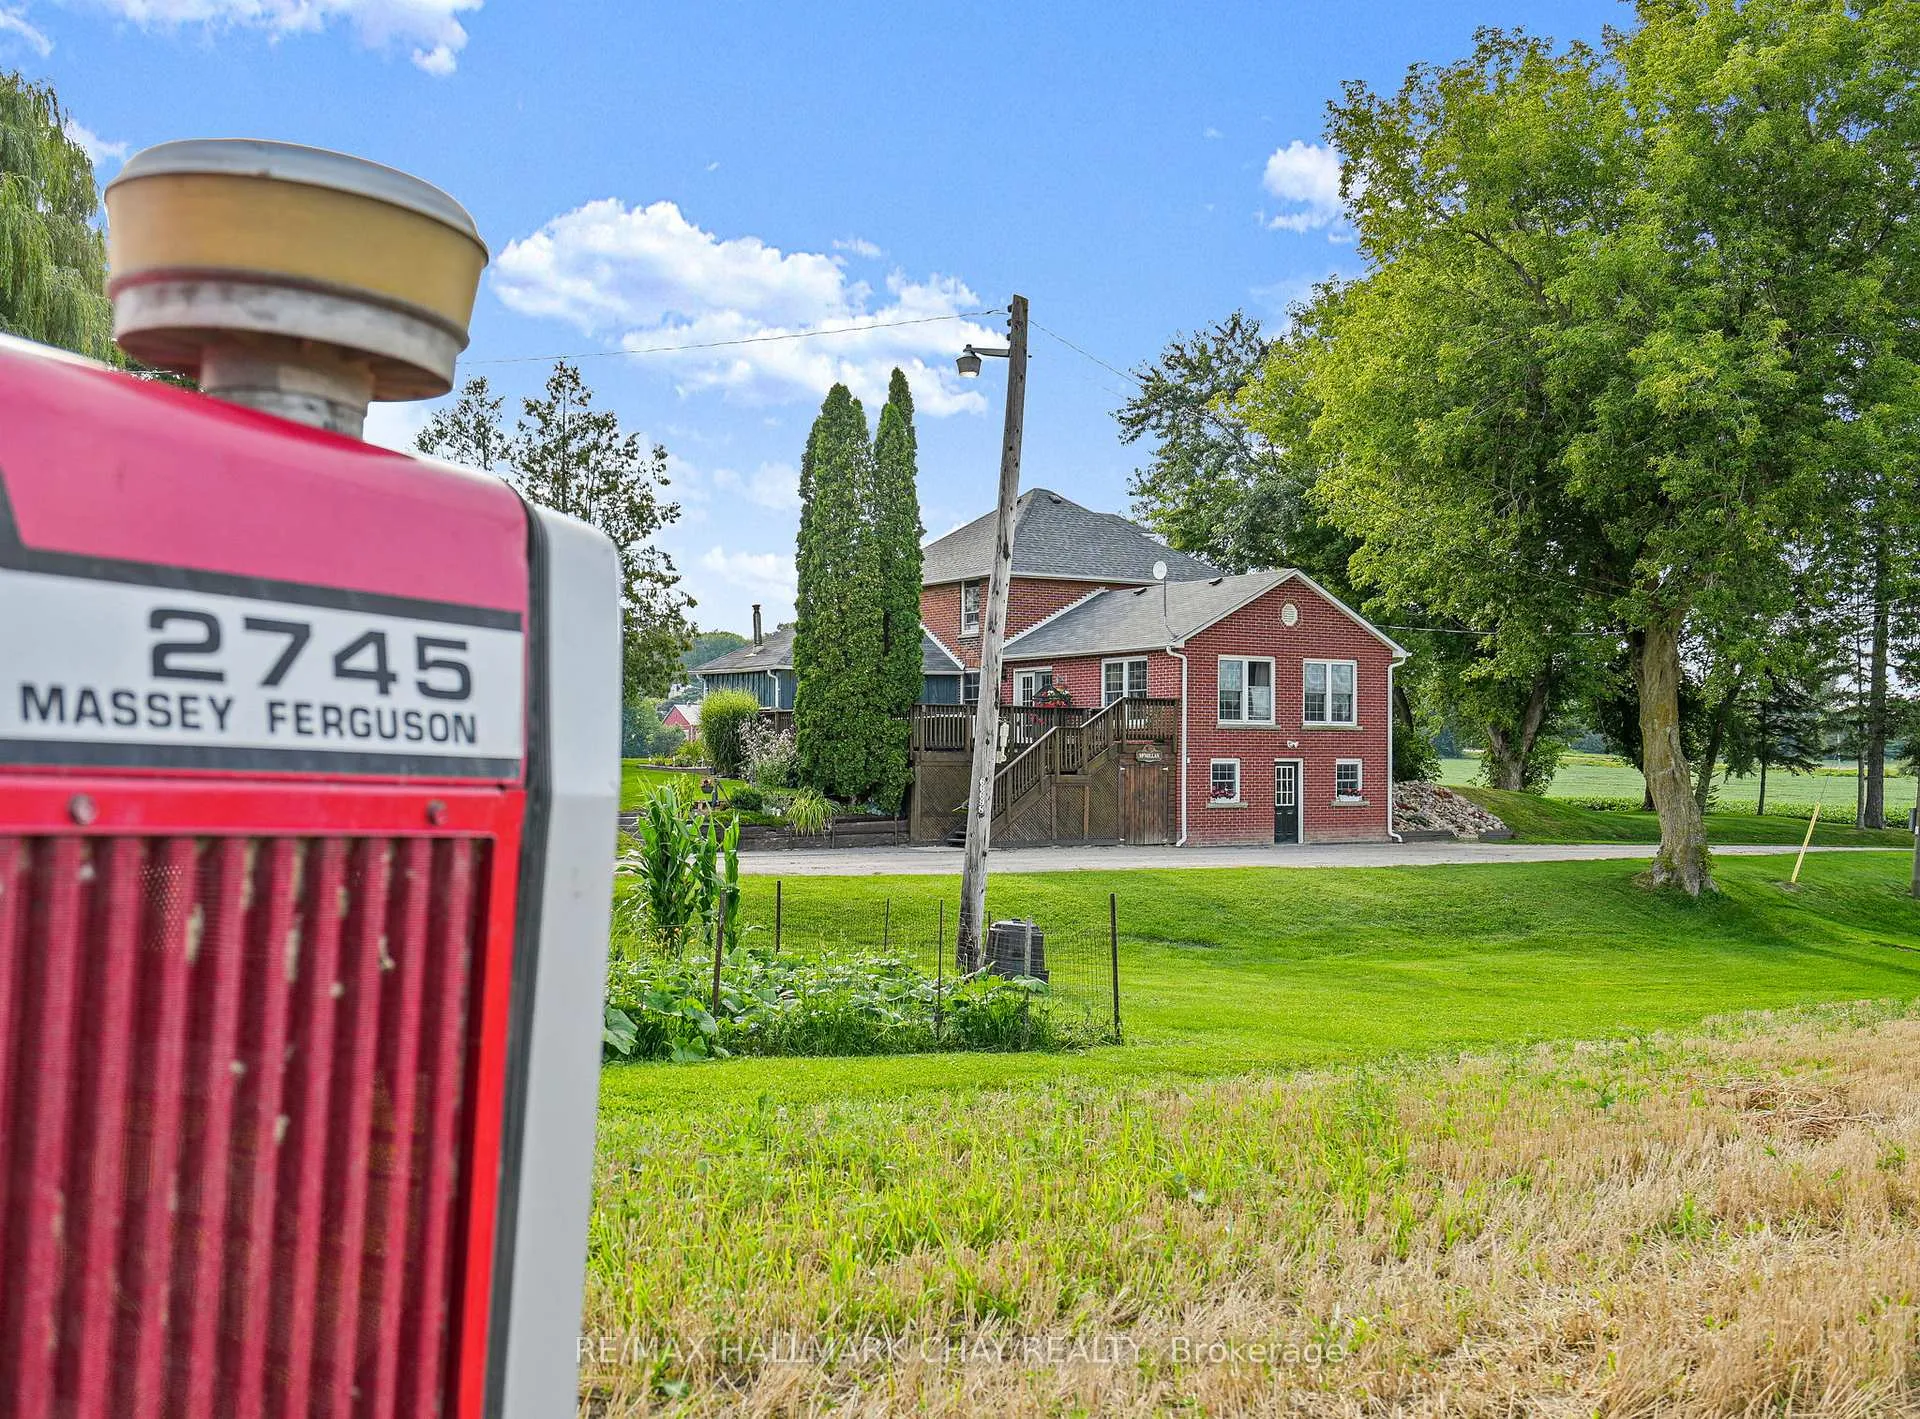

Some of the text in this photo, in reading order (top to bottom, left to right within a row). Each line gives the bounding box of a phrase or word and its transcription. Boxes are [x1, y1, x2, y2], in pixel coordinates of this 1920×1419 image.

[150, 608, 472, 701] 2745
[19, 682, 478, 744] MASSEY FERGUSON
